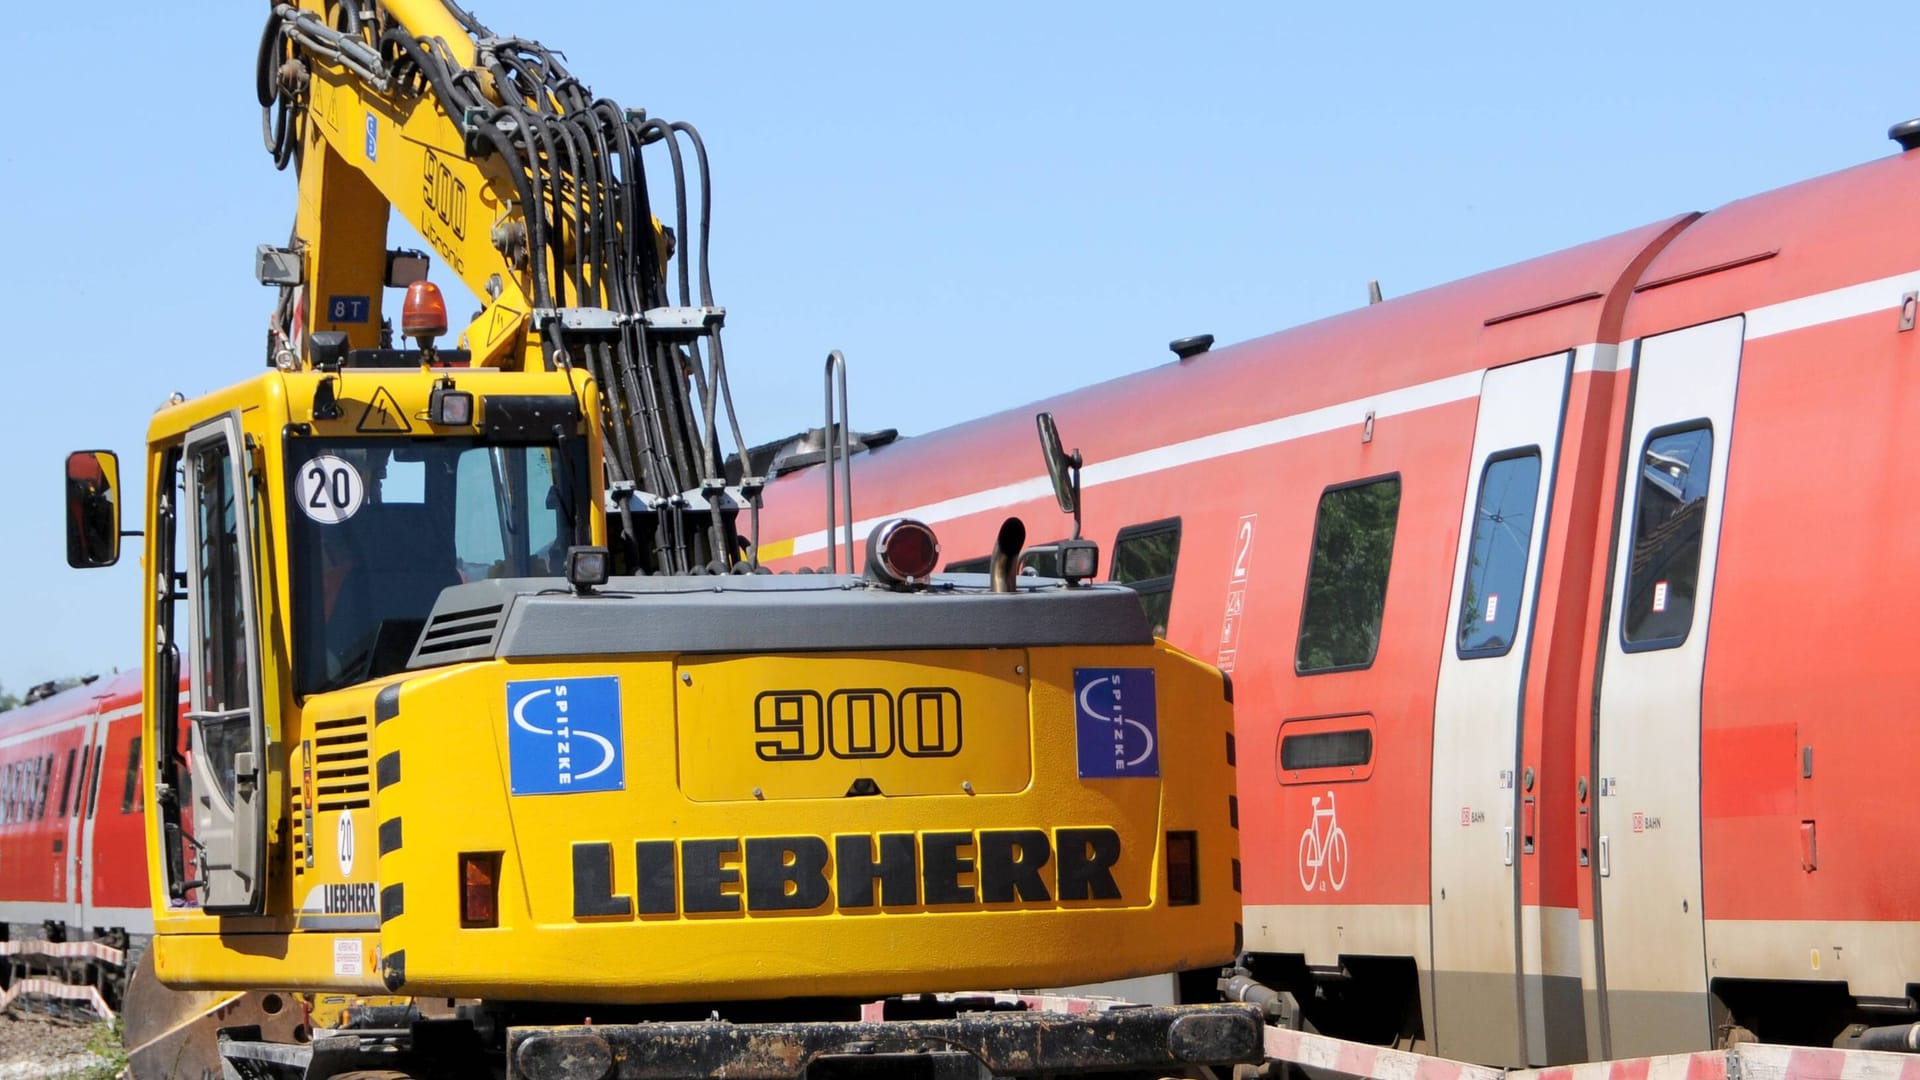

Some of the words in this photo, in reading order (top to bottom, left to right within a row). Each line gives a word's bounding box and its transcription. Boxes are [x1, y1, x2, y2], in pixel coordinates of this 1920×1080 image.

[423, 147, 467, 241] 900
[421, 210, 465, 276] Litronic
[334, 301, 345, 318] 8
[351, 301, 361, 318] T
[308, 467, 351, 509] 20
[1234, 521, 1251, 576] 2
[555, 684, 572, 785] SPITZKE
[754, 687, 962, 761] 900
[1111, 674, 1125, 770] SPITZKE
[340, 819, 352, 862] 20
[1471, 811, 1485, 823] BAHN
[1645, 816, 1661, 830] BAHN
[324, 883, 376, 914] LIEBHERR
[572, 827, 1123, 917] LIEBHERR
